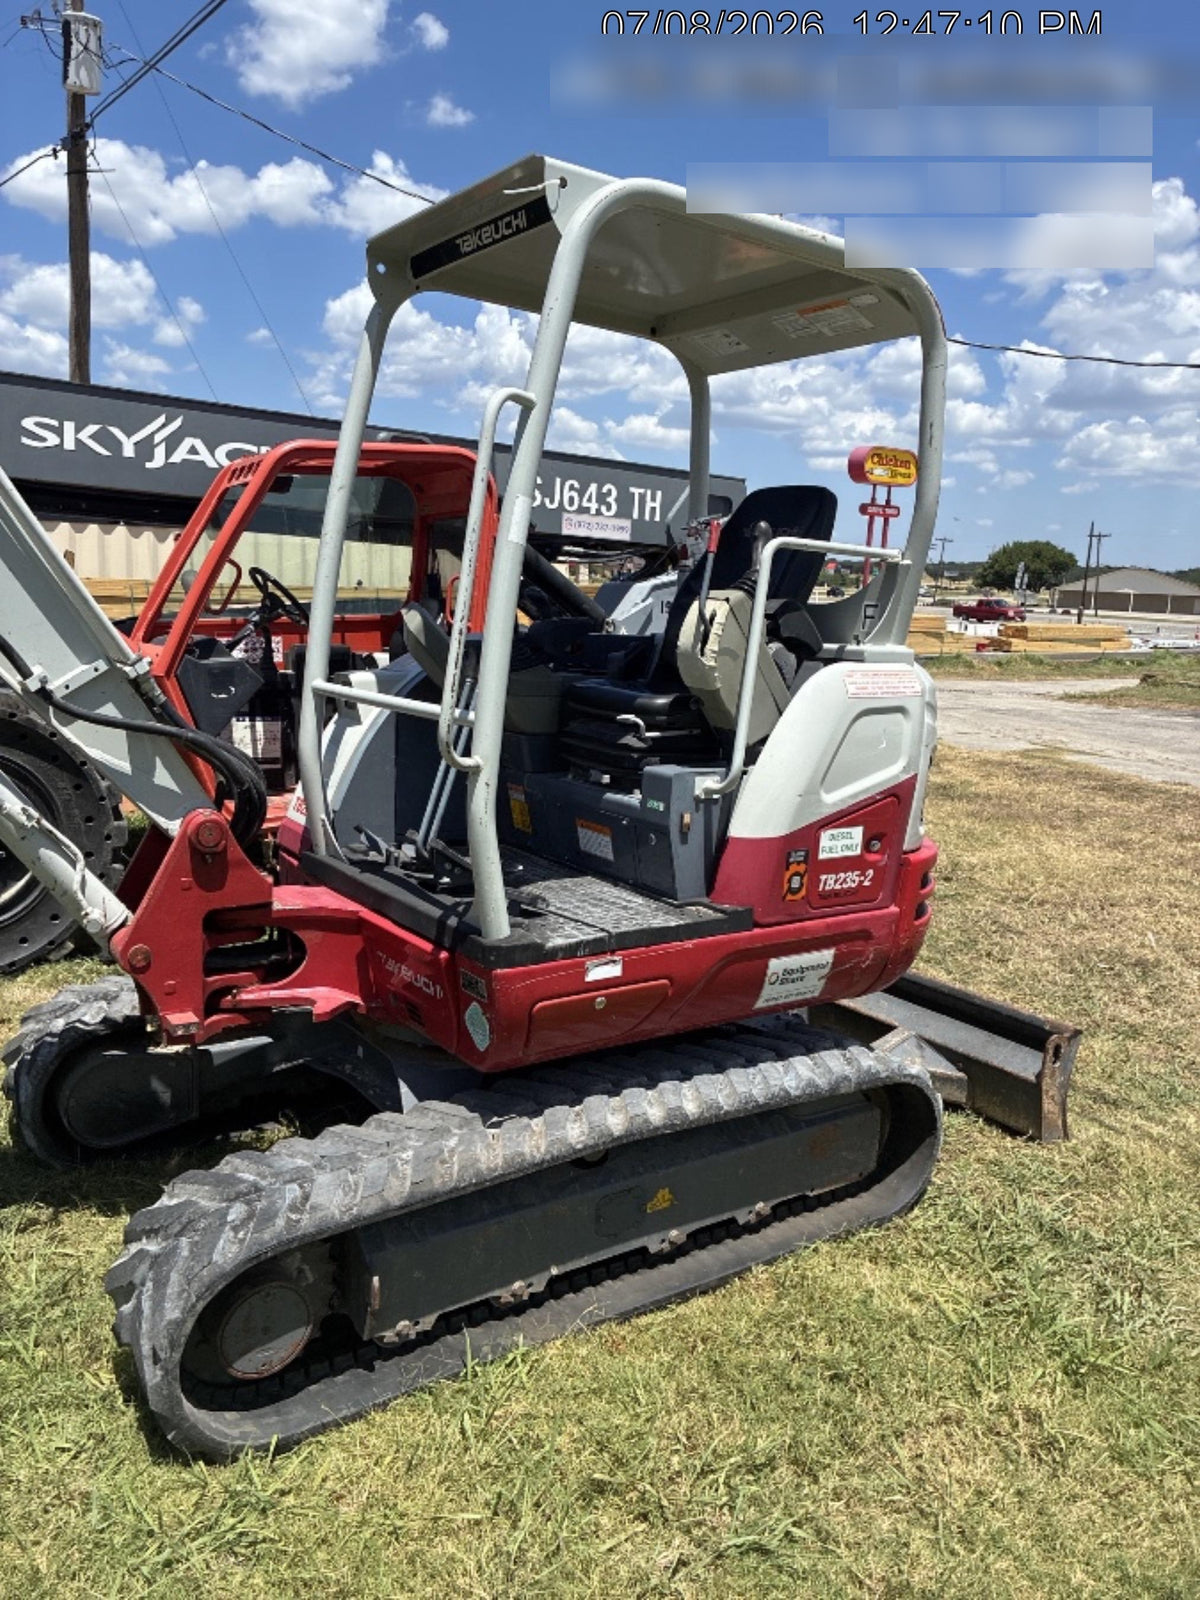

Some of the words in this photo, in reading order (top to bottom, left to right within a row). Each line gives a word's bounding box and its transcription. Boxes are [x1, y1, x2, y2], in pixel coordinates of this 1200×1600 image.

[20, 413, 272, 469] SKYJAC
[870, 452, 911, 470] Chicken
[628, 486, 662, 522] TH
[828, 831, 855, 842] DIESEL
[820, 845, 839, 855] FUEL
[818, 868, 875, 892] TB235-2
